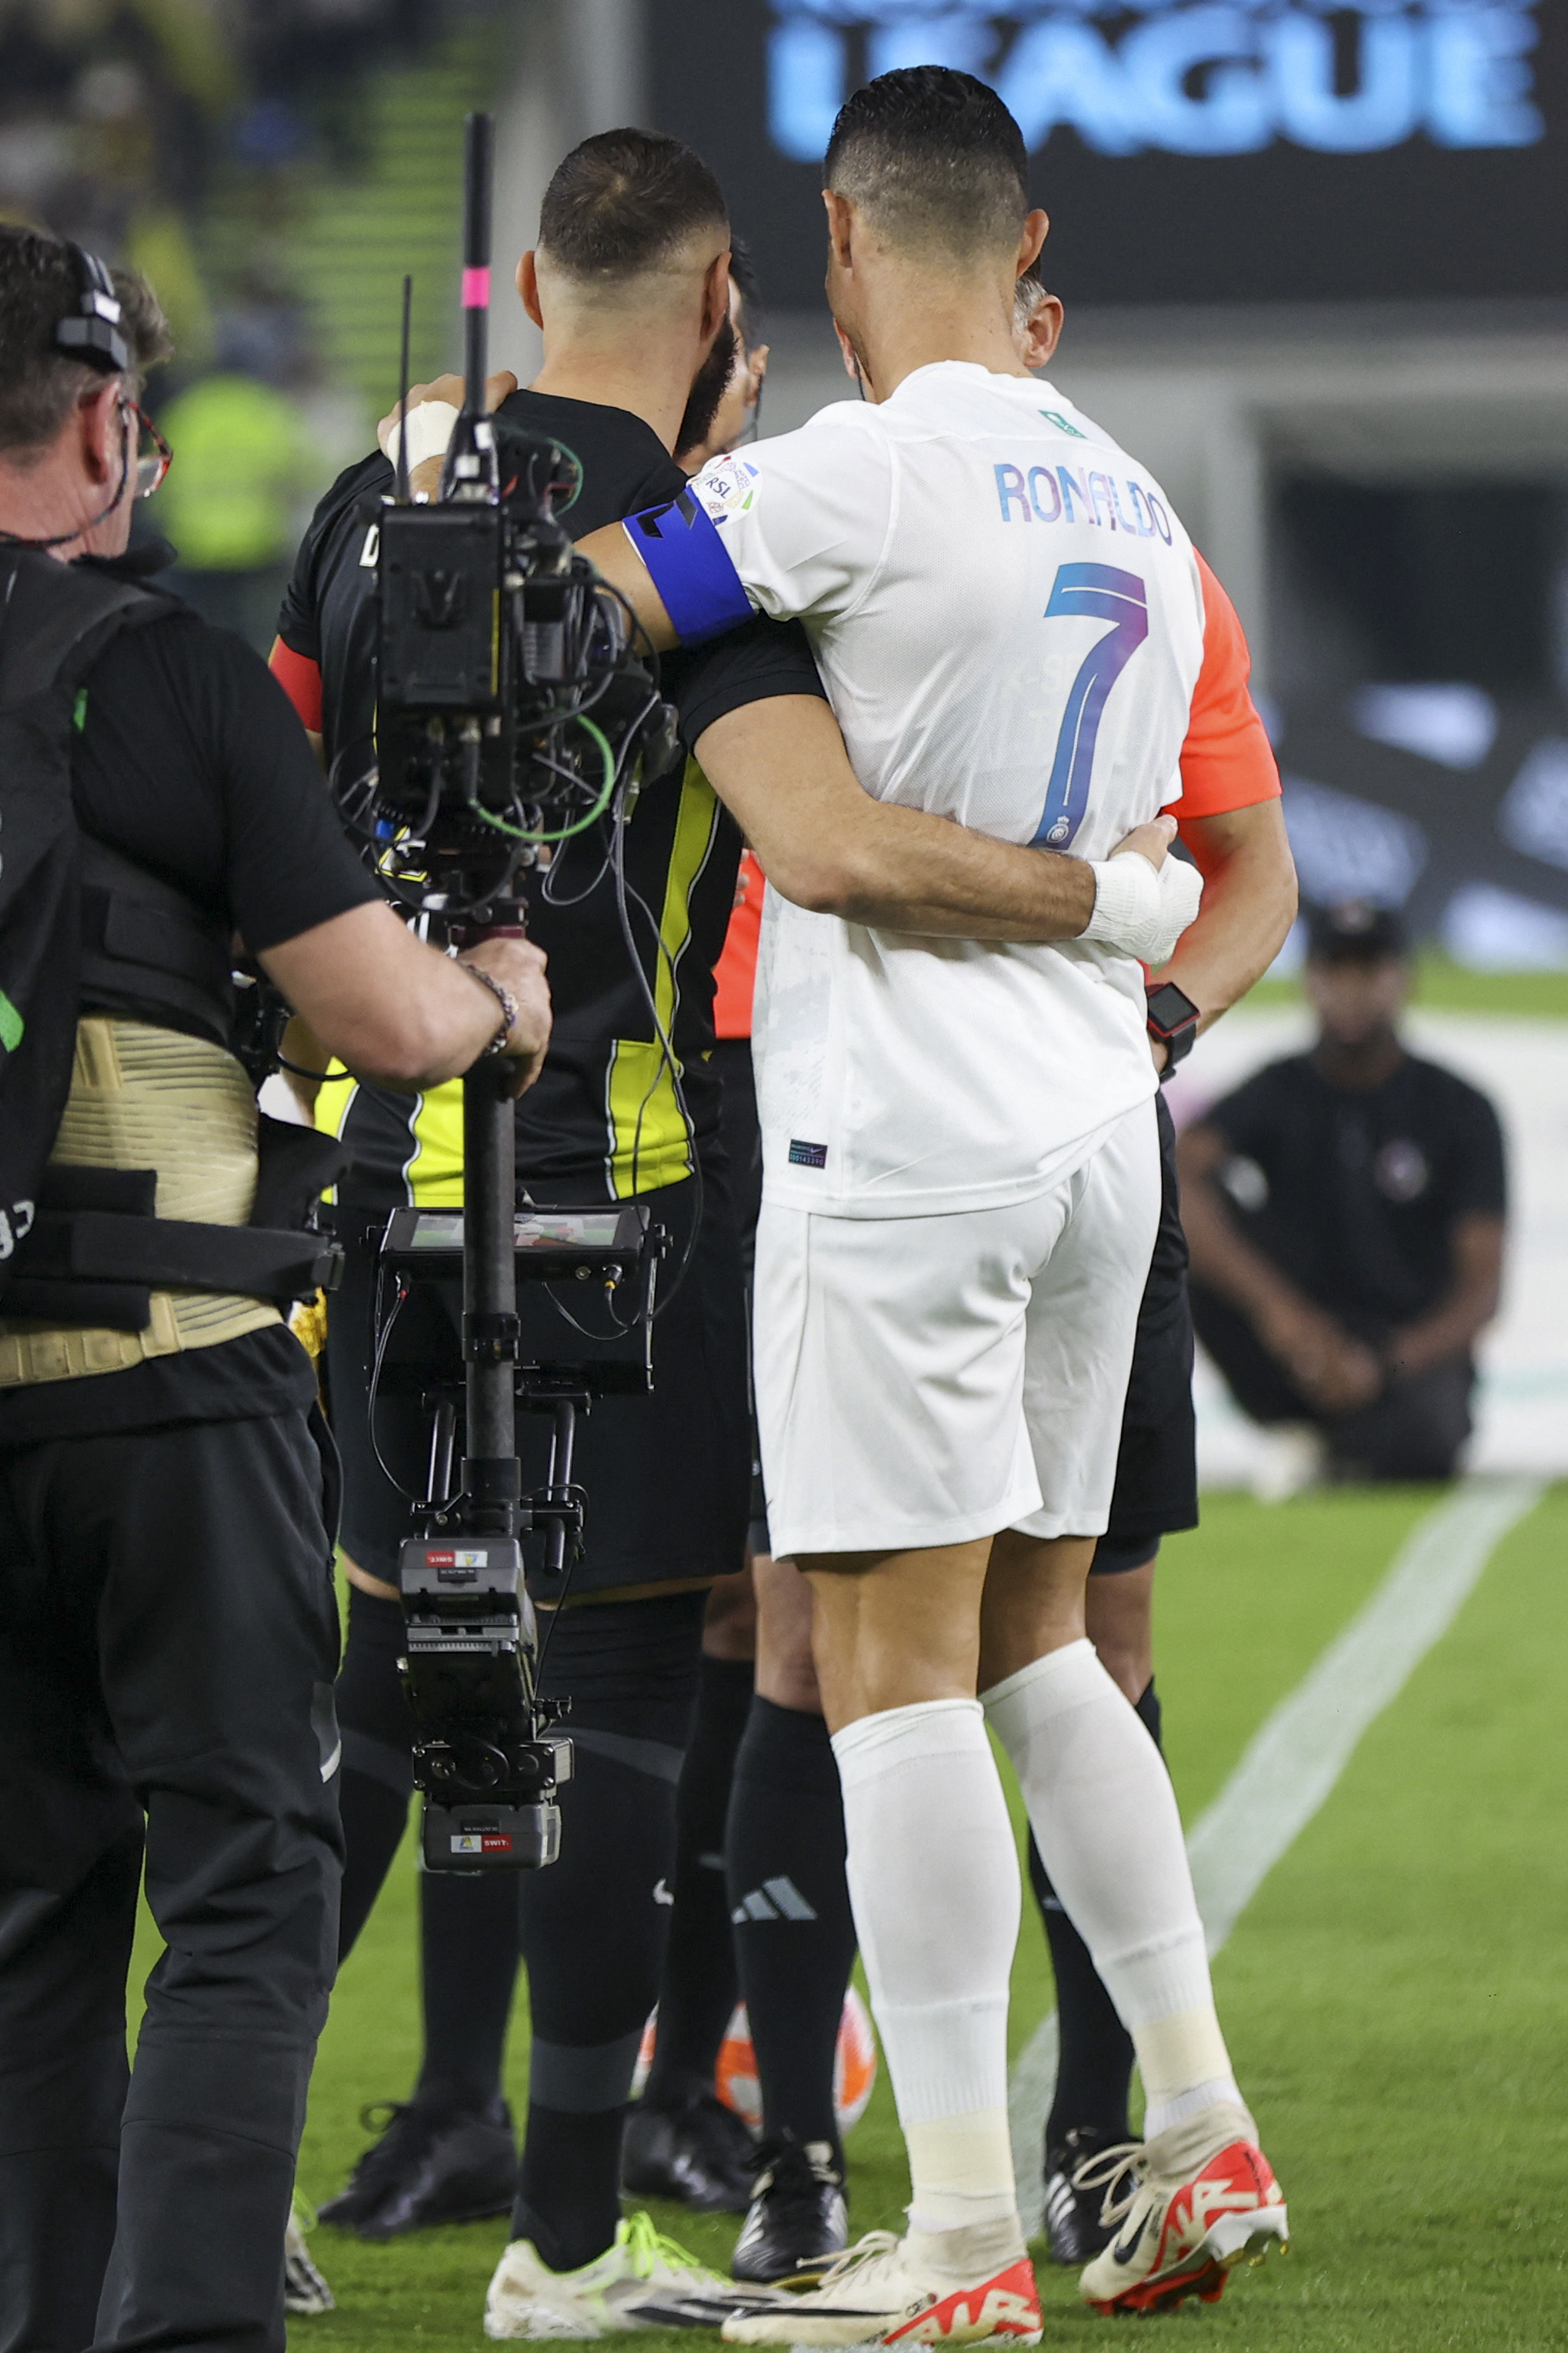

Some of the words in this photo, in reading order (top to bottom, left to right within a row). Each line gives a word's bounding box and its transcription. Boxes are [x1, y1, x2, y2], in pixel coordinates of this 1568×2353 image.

[706, 477, 732, 499] RSL
[993, 463, 1173, 546] RONALDO
[1026, 562, 1149, 850] 7
[484, 1838, 508, 1847] SWIT
